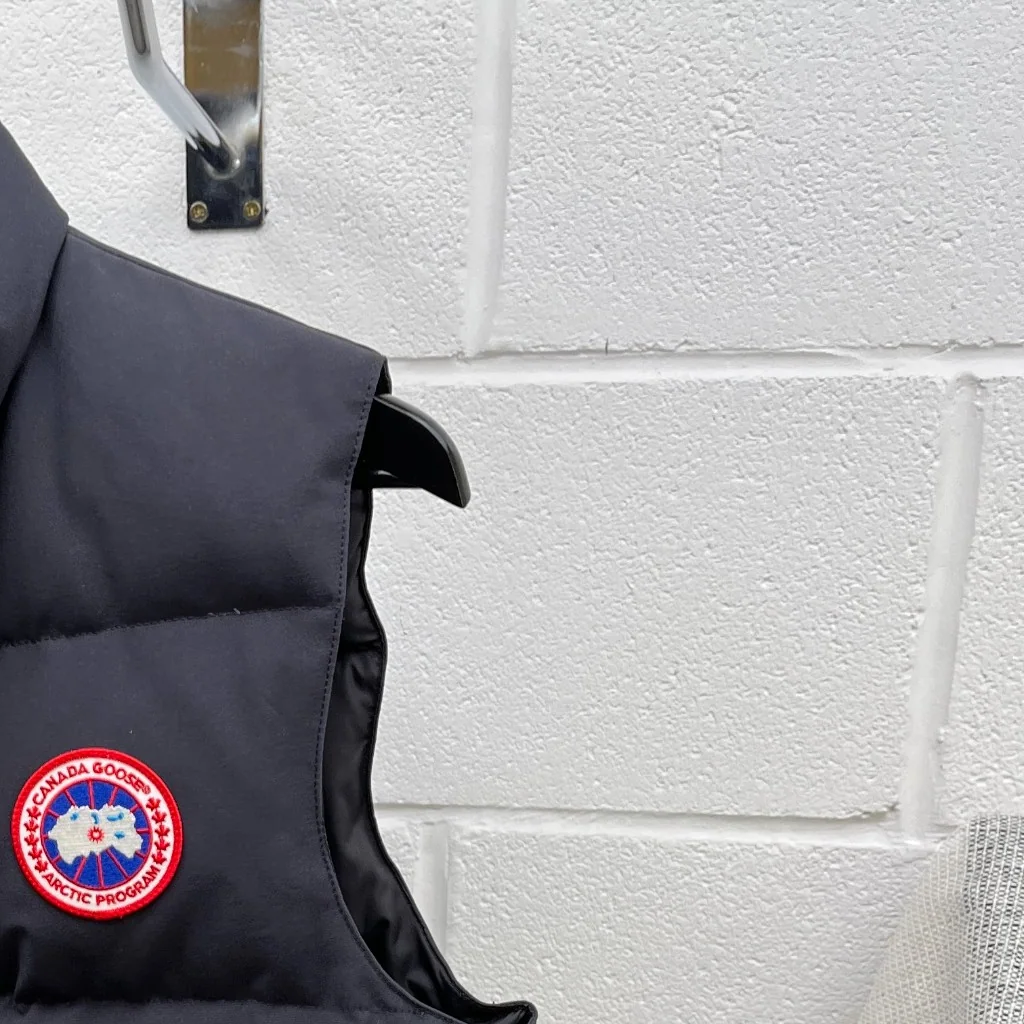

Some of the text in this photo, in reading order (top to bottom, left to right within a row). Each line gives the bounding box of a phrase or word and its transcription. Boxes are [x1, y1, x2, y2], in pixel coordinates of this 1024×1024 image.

[33, 763, 89, 805] CANADA
[43, 866, 160, 906] ARCTIC PROGRAM
